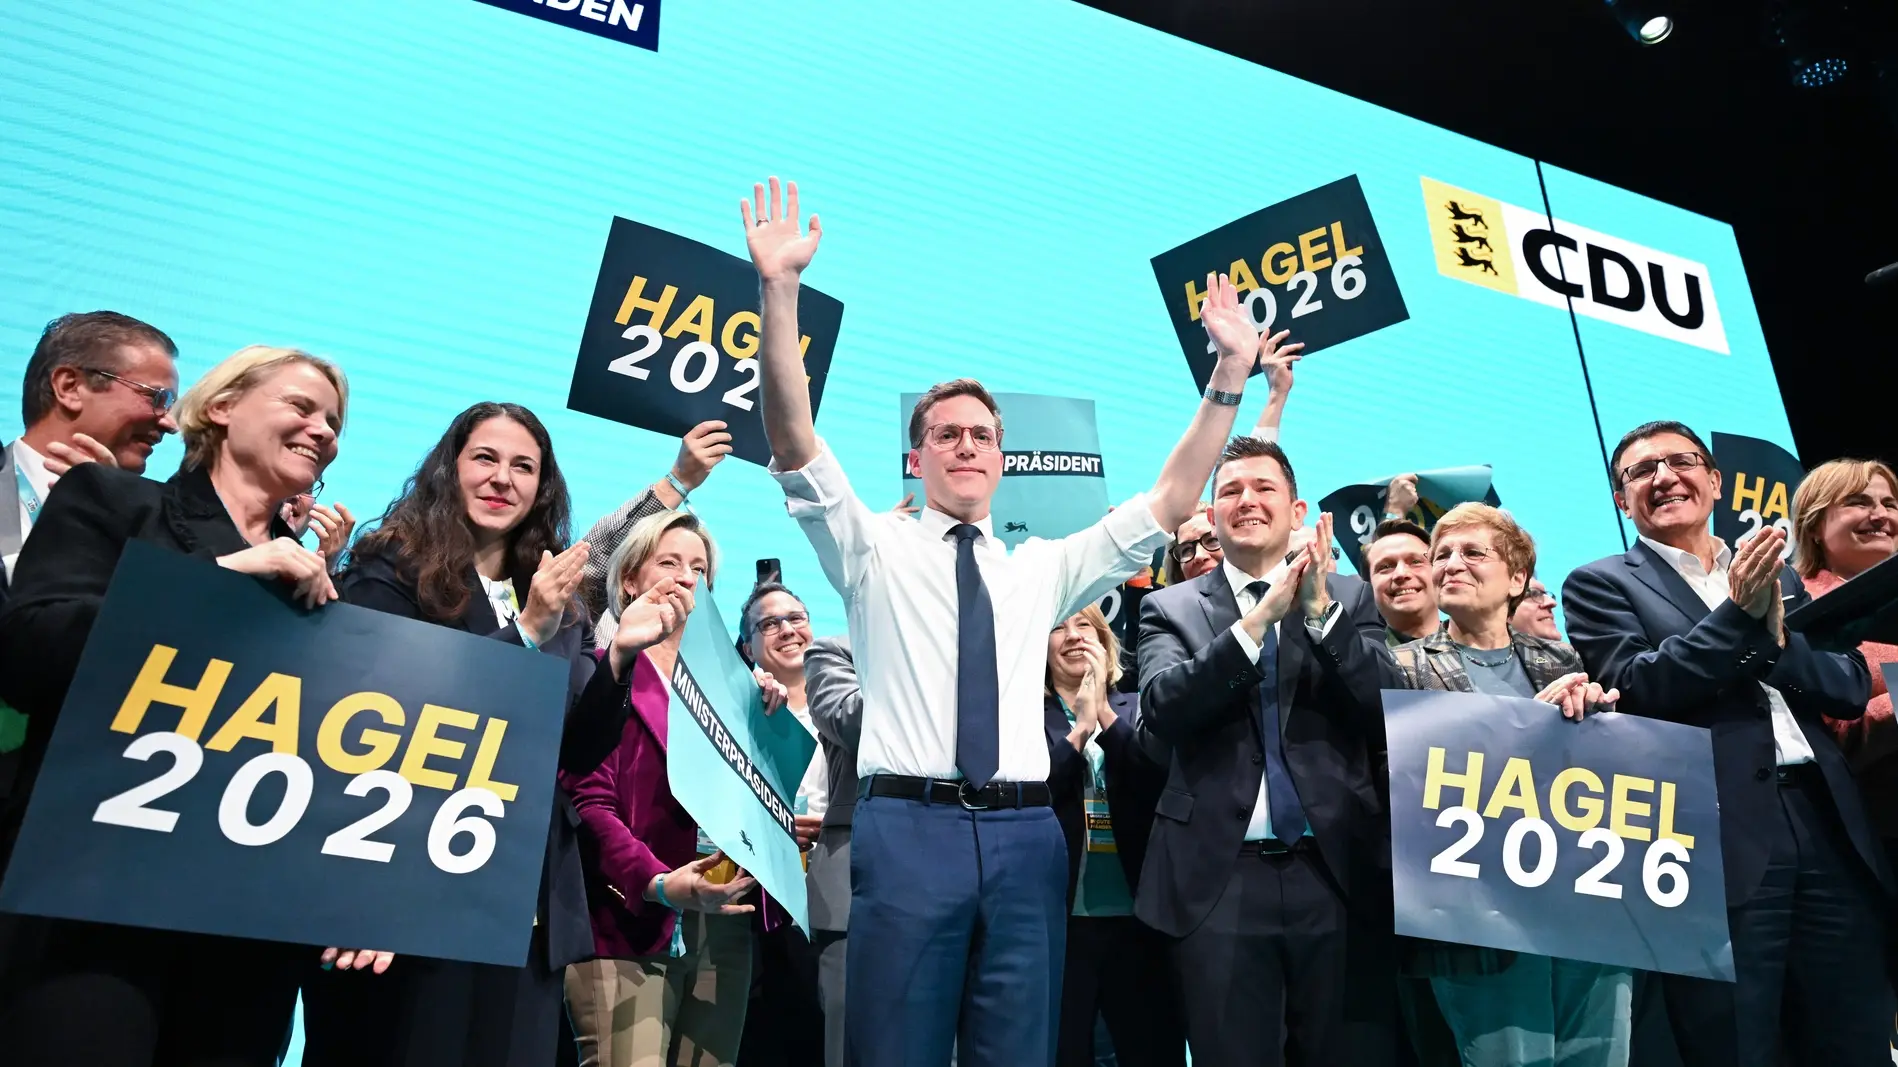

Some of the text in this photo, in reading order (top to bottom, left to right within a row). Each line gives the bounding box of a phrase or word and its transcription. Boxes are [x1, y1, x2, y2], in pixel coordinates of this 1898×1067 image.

[1185, 221, 1364, 322] HAGEL
[1202, 254, 1367, 354] 026
[1522, 228, 1704, 330] CDU
[607, 324, 761, 412] 202
[614, 275, 811, 386] HAG
[1735, 509, 1796, 560] 20
[110, 643, 519, 802] HAGEL
[673, 662, 794, 833] MINISTERPRÄSIDENT
[92, 731, 505, 874] 2026
[1422, 747, 1695, 850] HAGEL
[1429, 806, 1692, 908] 2026
